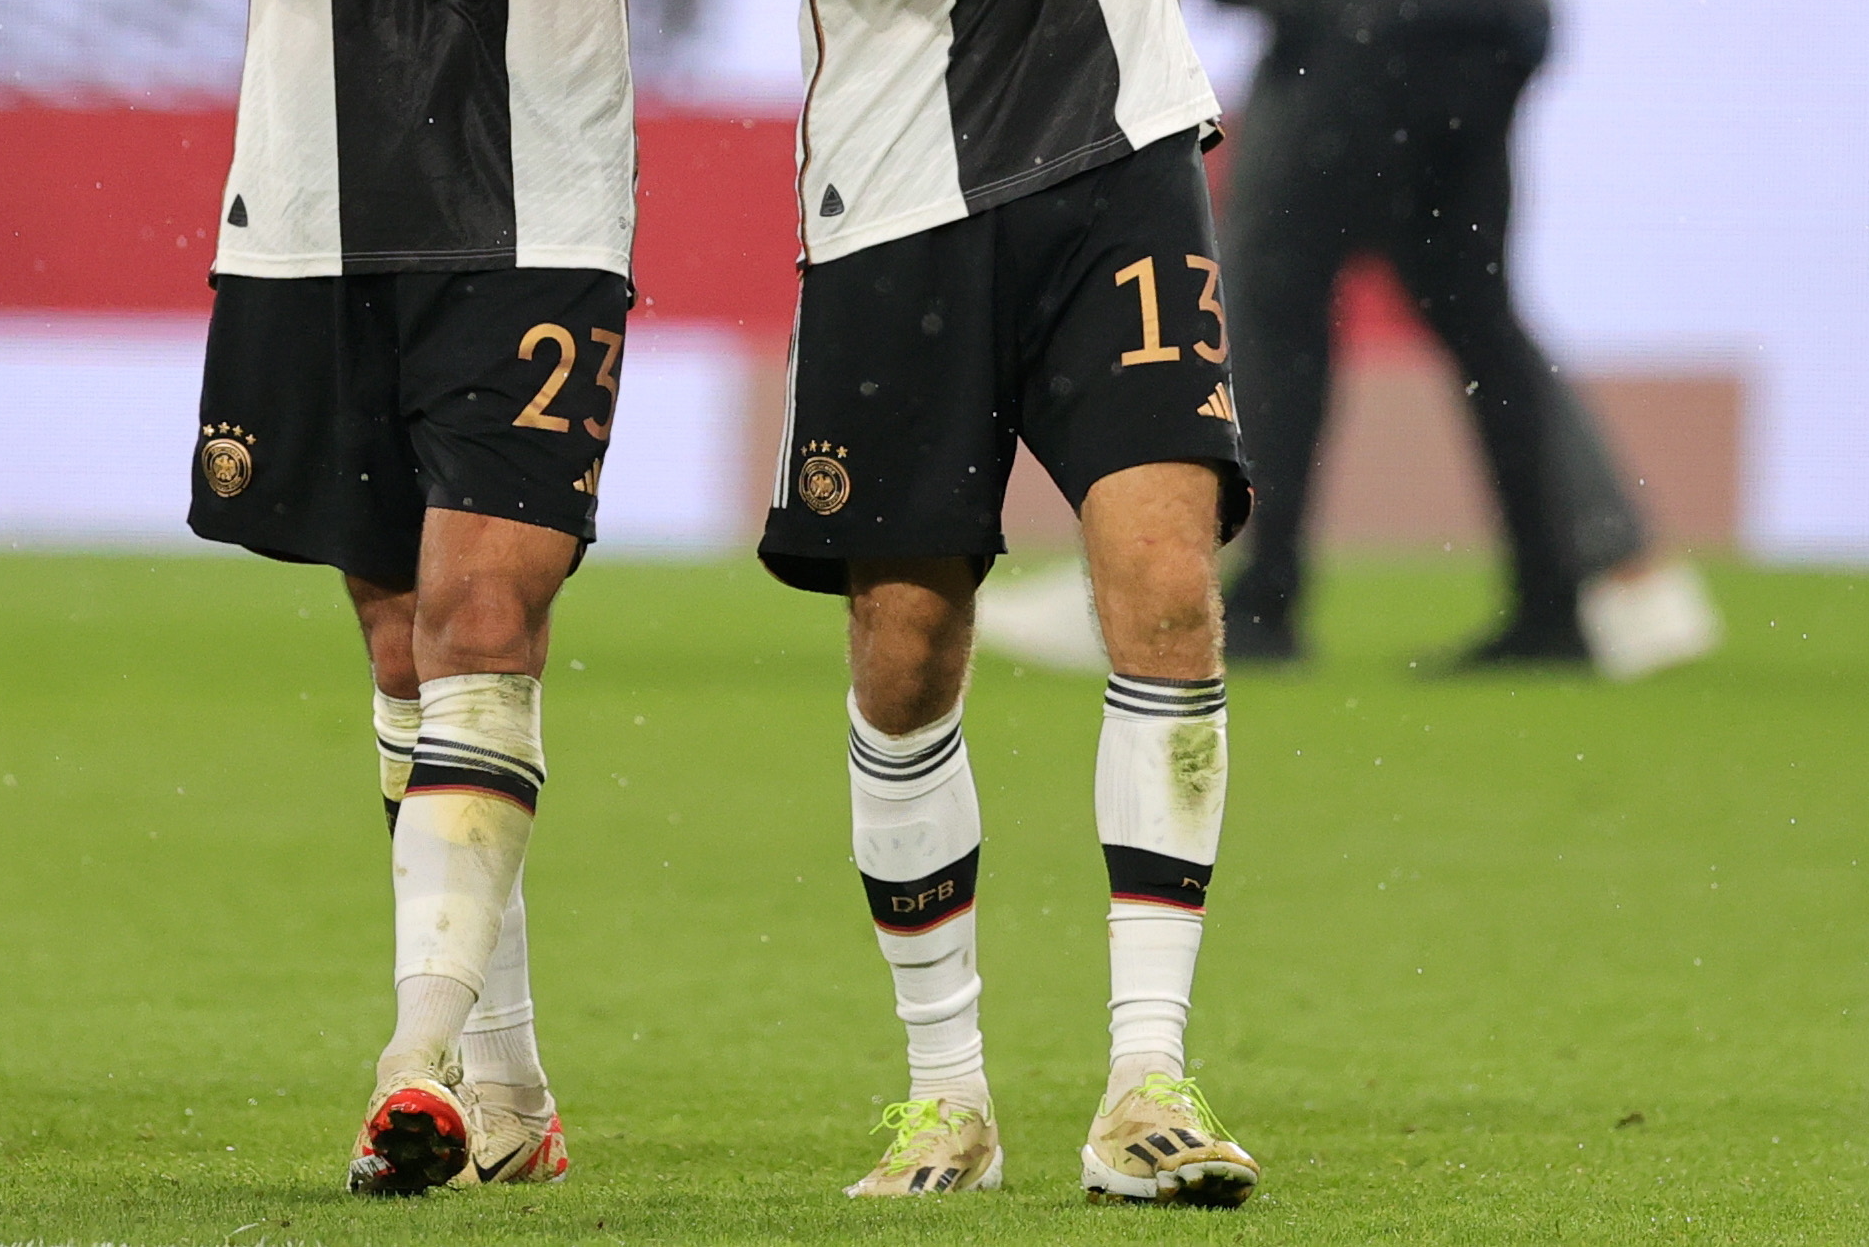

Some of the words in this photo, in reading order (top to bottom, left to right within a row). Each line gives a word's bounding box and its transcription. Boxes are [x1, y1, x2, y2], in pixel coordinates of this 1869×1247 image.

[1115, 254, 1228, 367] 13
[512, 322, 624, 441] 23
[891, 879, 955, 913] DFB
